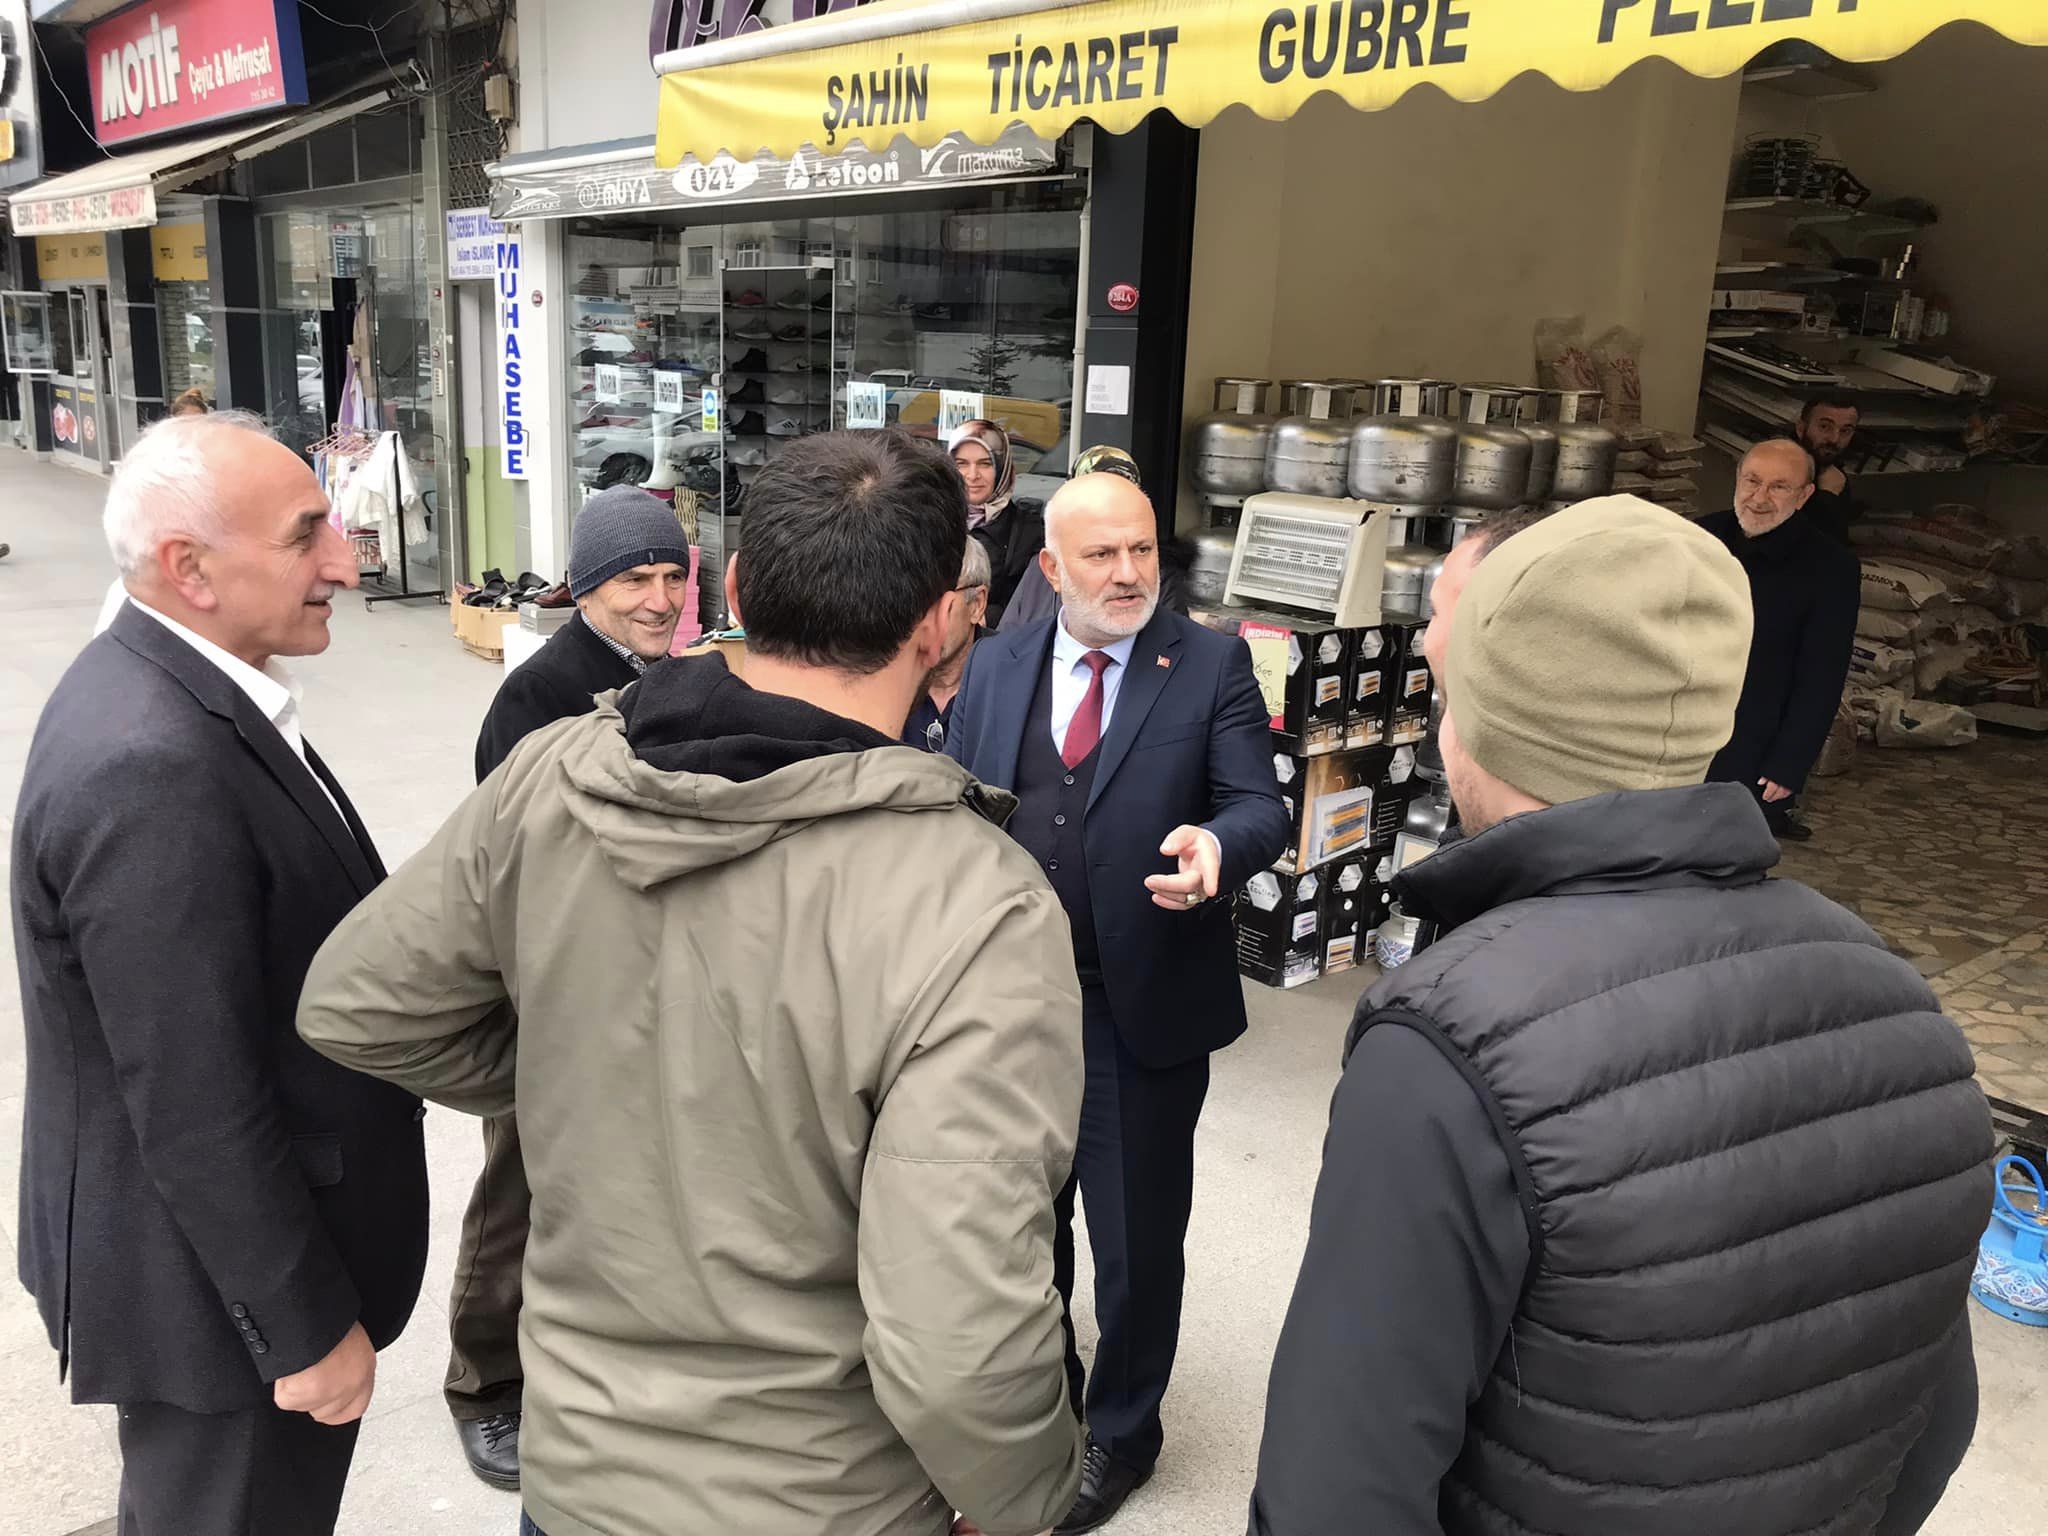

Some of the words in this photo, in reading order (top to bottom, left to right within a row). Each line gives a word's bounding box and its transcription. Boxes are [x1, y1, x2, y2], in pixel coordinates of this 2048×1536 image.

[101, 12, 181, 123] MOTİF
[214, 53, 225, 88] &
[822, 52, 930, 146] ŞAHİN
[987, 26, 1179, 115] TİCARET
[496, 243, 523, 474] MUHASEBE
